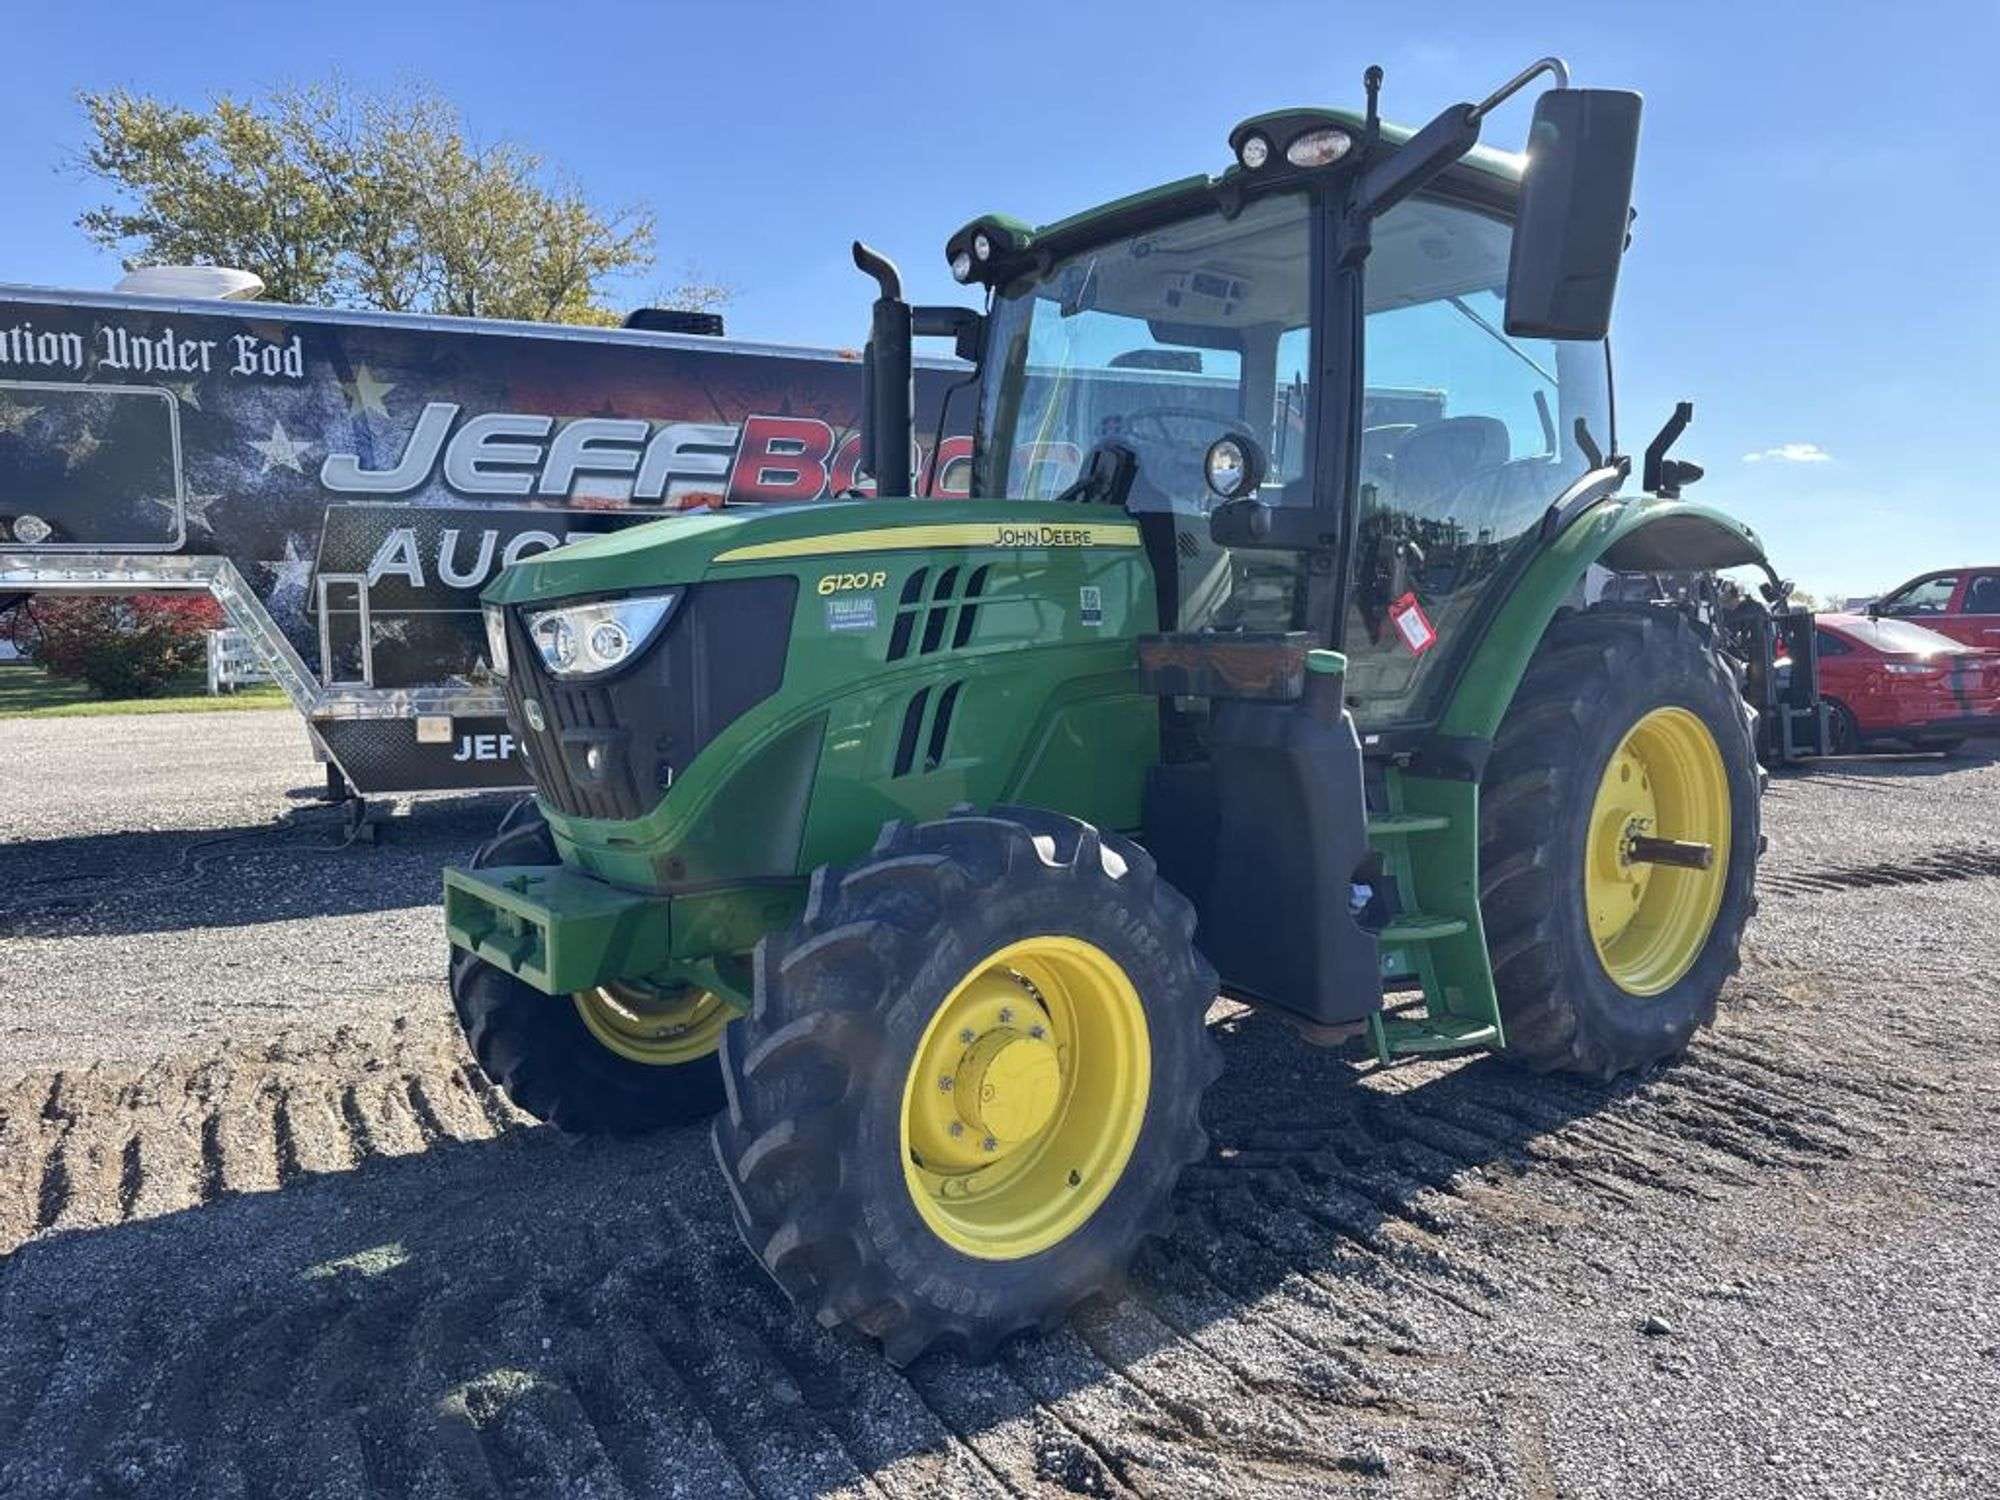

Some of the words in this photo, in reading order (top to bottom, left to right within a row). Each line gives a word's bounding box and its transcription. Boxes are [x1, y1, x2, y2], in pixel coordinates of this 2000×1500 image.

[99, 326, 217, 373] Under
[994, 527, 1039, 545] JOHN
[1040, 527, 1092, 545] DEERE
